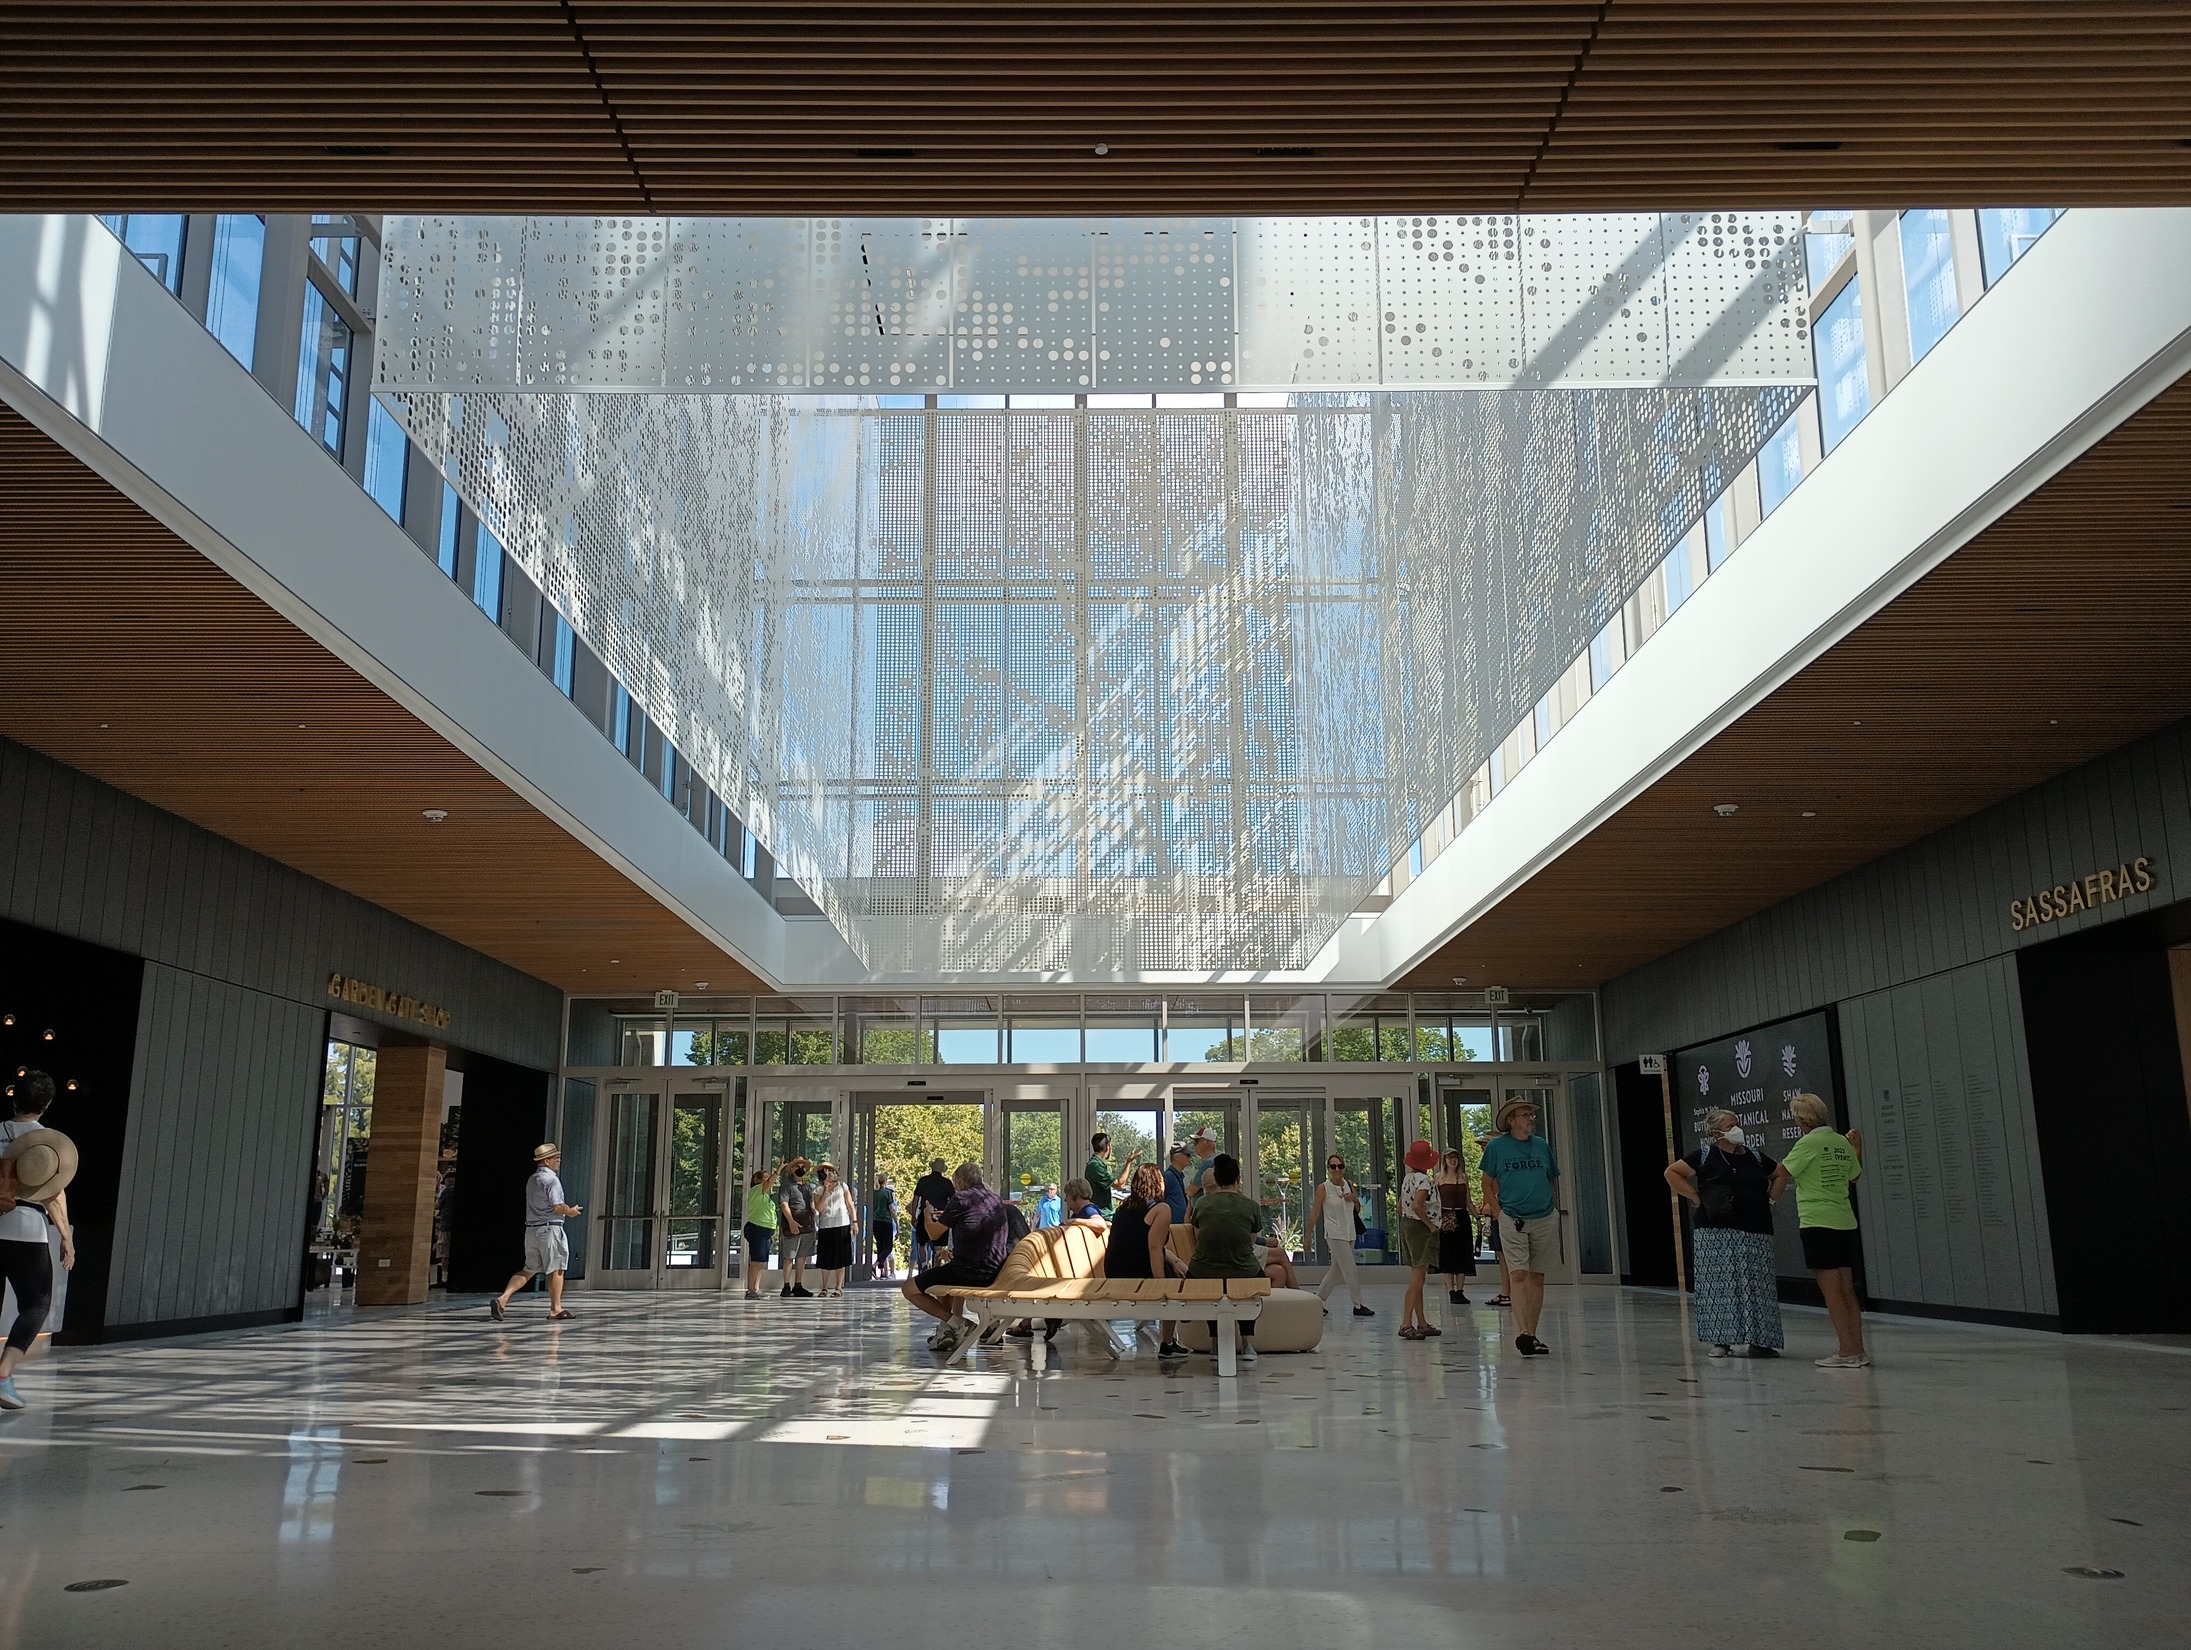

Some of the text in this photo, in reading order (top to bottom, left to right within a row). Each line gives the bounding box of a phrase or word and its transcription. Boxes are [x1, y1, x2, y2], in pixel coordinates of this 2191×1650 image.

[2010, 856, 2152, 931] SASSAFRAS
[328, 972, 386, 1011] GARDEN
[1490, 990, 1504, 1002] EXIT
[659, 994, 674, 1005] EXIT
[1730, 1087, 1764, 1107] MISSOURI
[1781, 1109, 1794, 1121] NAT
[1740, 1132, 1766, 1148] ARDEN
[1782, 1126, 1804, 1140] RESER
[1505, 1160, 1543, 1170] FORGE
